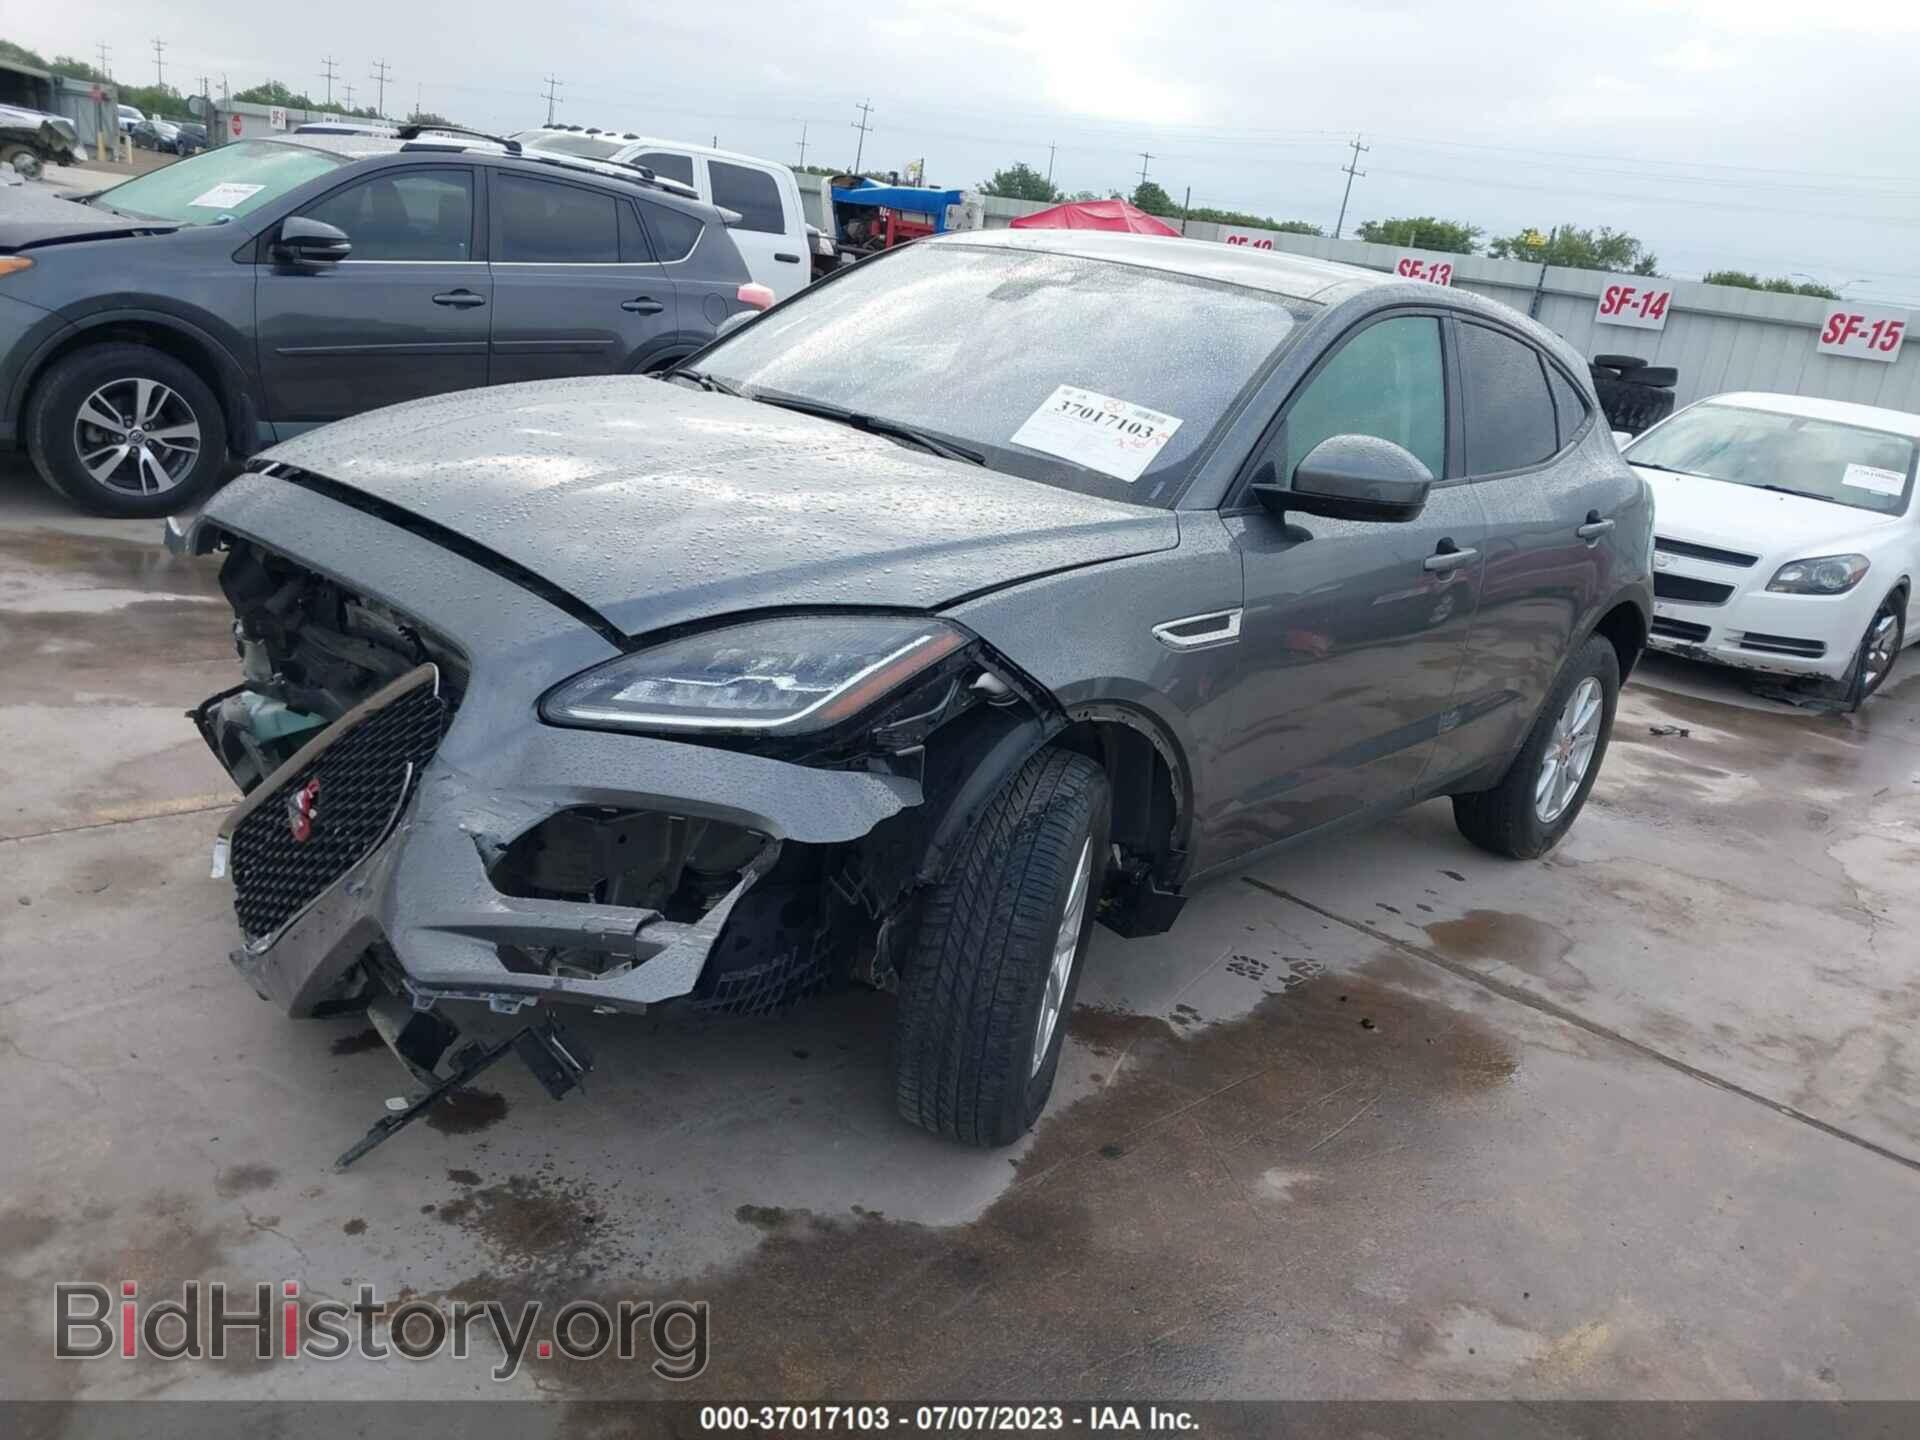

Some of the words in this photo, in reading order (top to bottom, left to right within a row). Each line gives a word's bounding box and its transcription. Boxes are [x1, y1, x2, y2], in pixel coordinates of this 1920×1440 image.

[1599, 285, 1670, 320] SF-14
[1821, 312, 1905, 352] SF-15
[1053, 400, 1155, 438] 37017103
